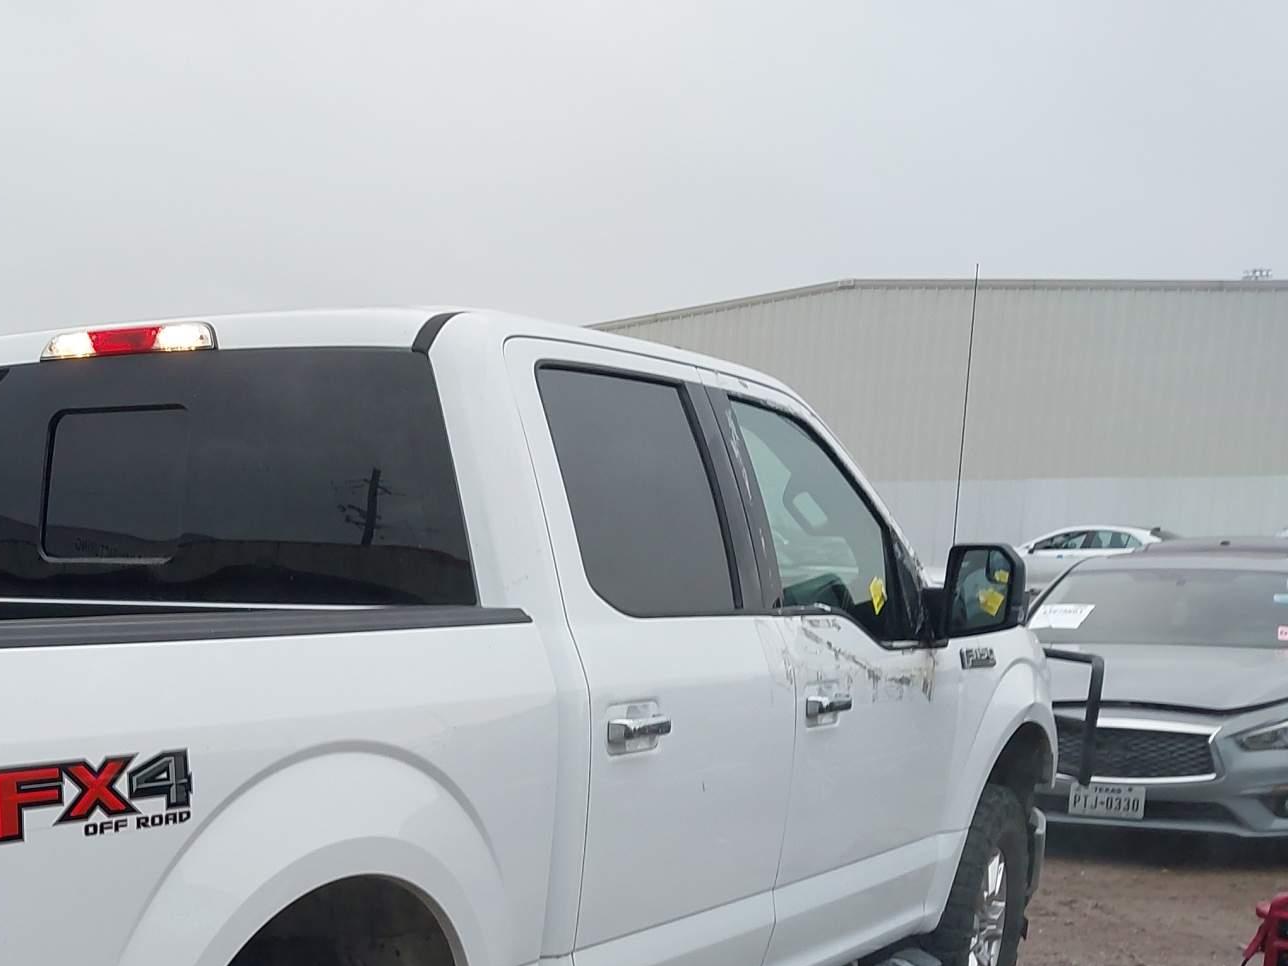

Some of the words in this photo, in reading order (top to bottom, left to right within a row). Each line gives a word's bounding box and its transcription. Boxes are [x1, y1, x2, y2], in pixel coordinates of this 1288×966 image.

[1073, 793, 1140, 812] PTJ-0330
[83, 817, 129, 837] OFF
[136, 809, 192, 830] ROAD
